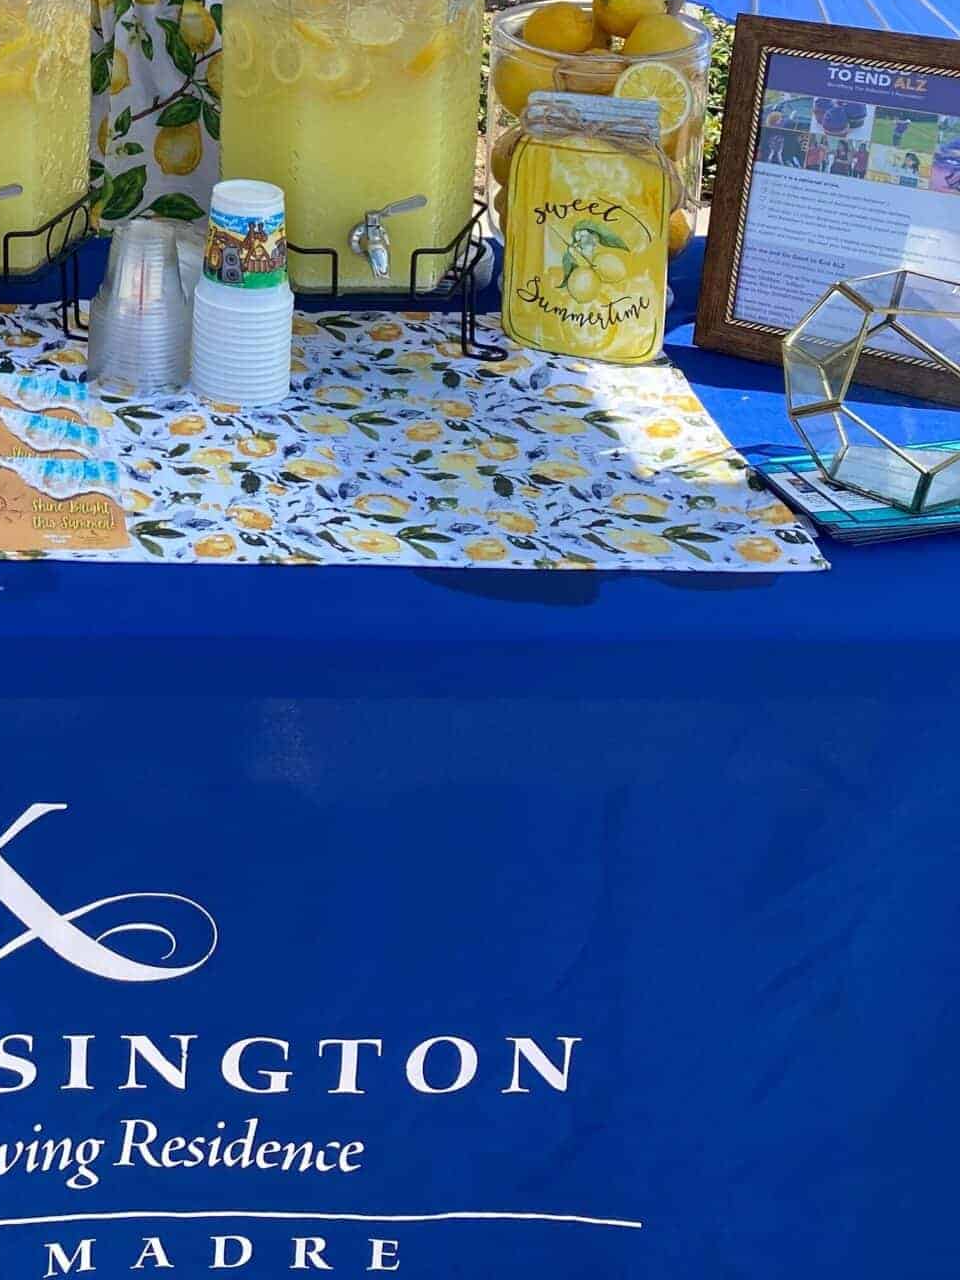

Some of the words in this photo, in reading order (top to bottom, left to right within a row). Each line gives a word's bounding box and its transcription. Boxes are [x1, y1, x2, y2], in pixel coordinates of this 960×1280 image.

[827, 67, 852, 82] TO
[854, 69, 891, 87] END
[893, 78, 929, 93] ALZ
[516, 276, 650, 330] Summertime
[113, 1118, 365, 1174] Residence
[42, 1234, 401, 1279] MADRE
